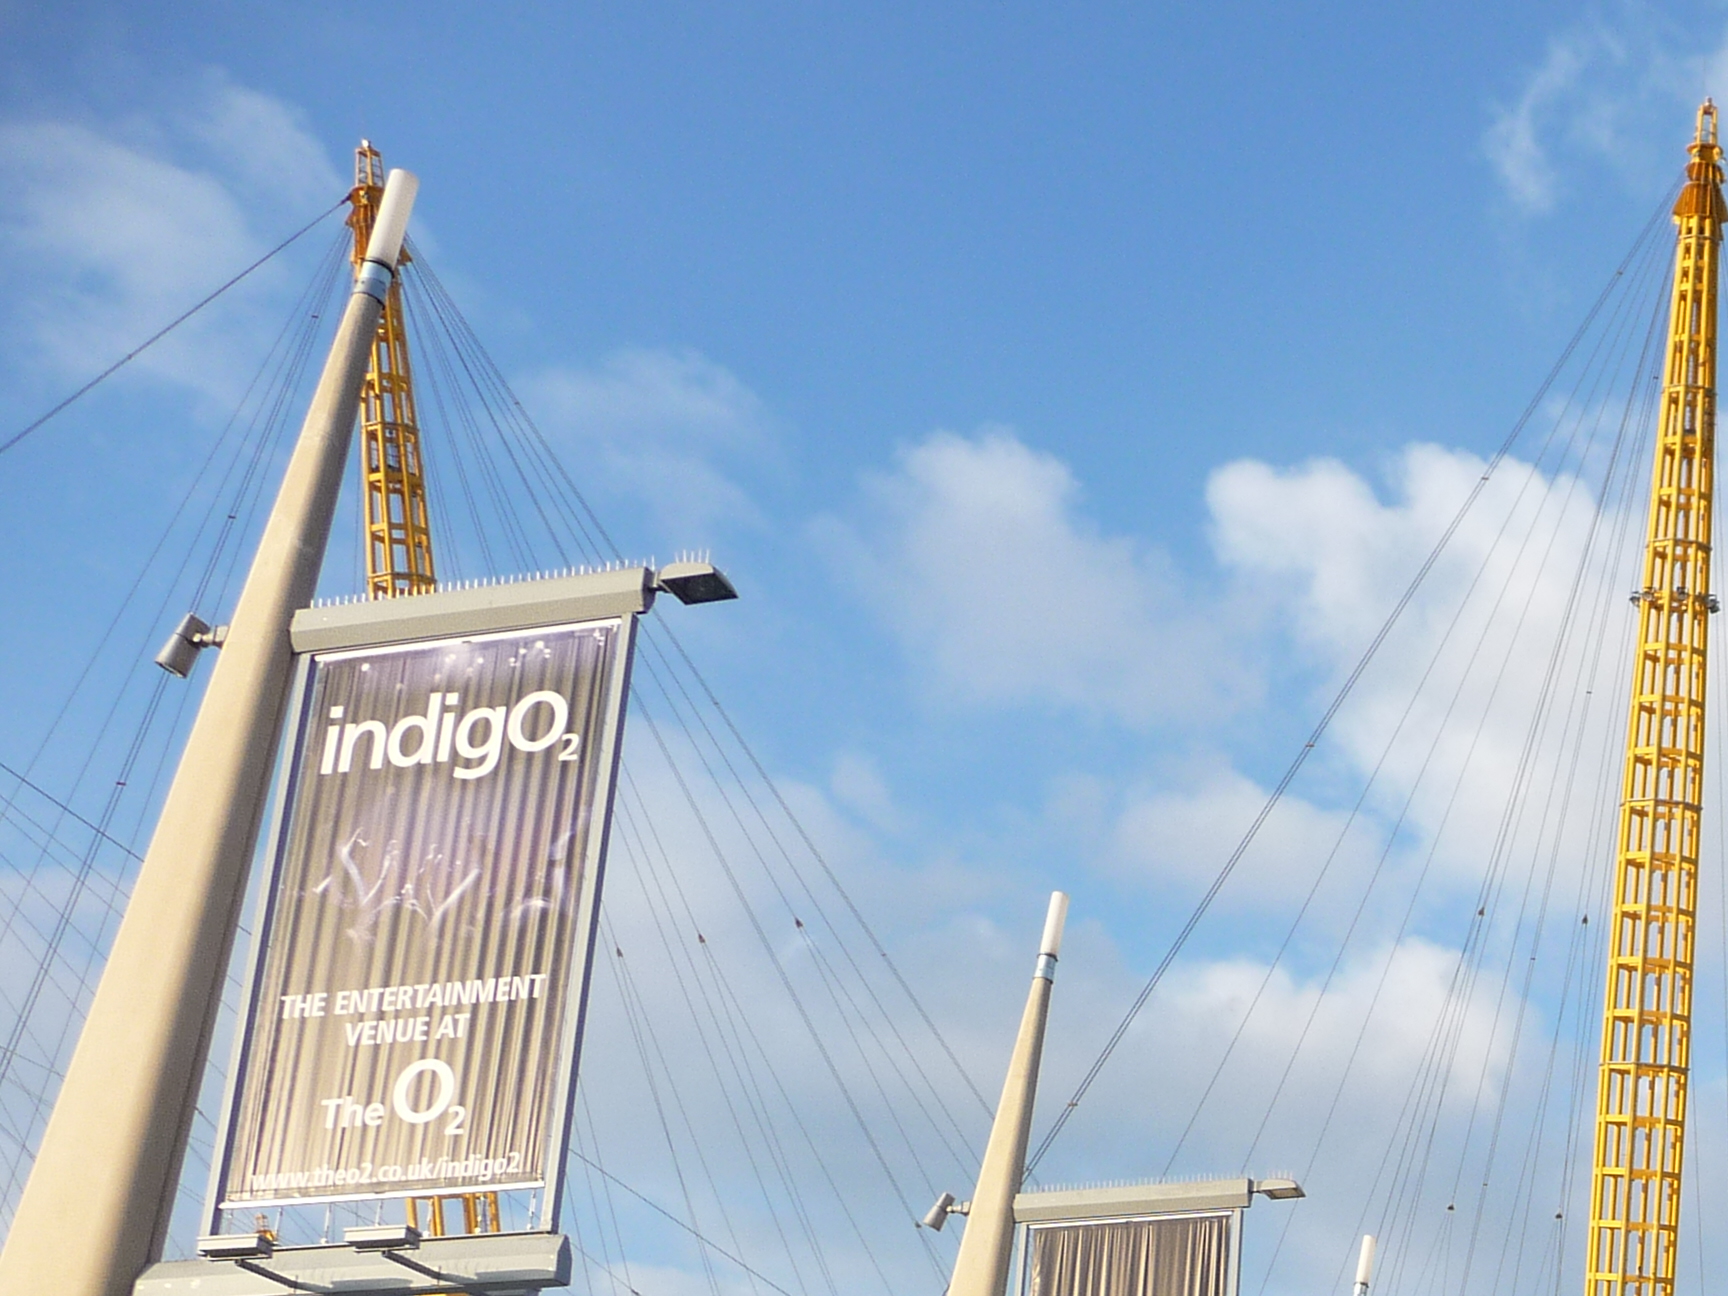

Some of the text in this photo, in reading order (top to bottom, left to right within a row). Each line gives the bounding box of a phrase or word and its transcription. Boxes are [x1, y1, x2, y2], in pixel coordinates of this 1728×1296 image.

[281, 973, 547, 1020] THE ENTERTAINMENT
[345, 1013, 471, 1047] VENUE AT
[321, 1096, 386, 1130] The
[250, 1151, 521, 1192] www.theo2.co.uk/indigo2
